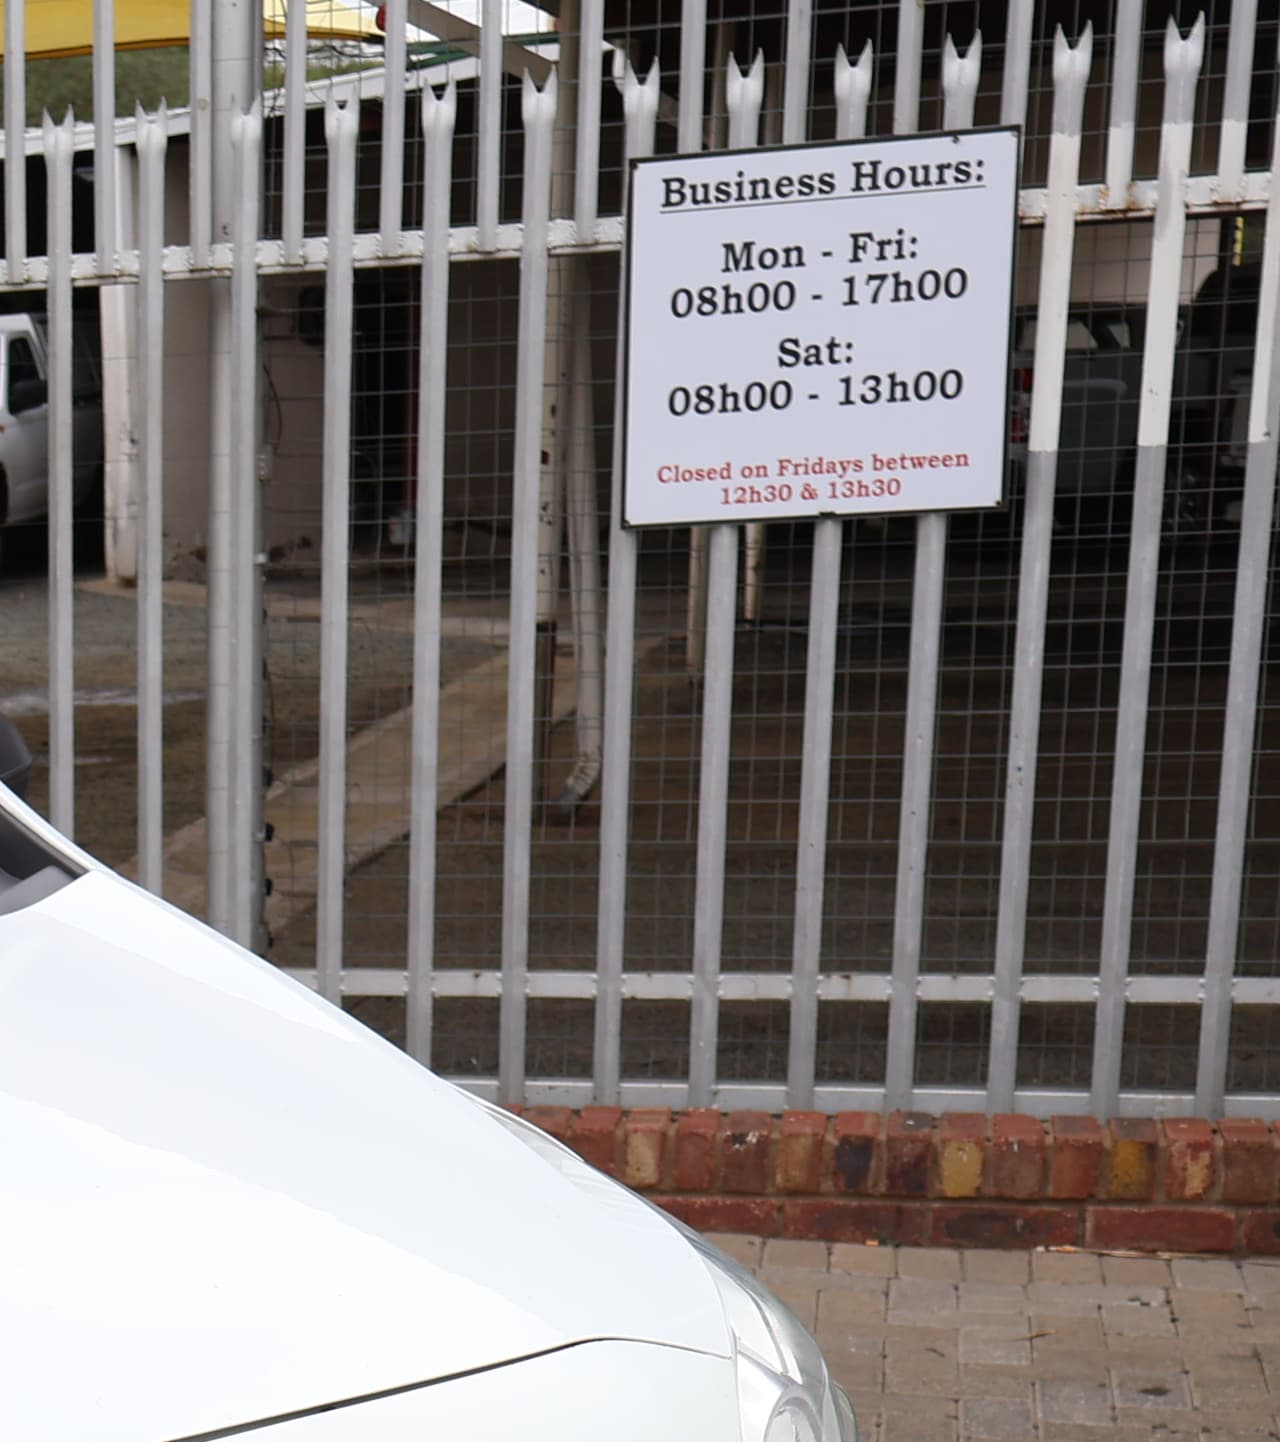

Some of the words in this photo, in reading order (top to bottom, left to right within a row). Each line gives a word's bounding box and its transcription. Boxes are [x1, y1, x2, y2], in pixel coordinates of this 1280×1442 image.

[659, 170, 836, 210] Business
[850, 157, 987, 194] Hours:
[721, 241, 806, 273] Mon
[848, 228, 918, 264] Fri:
[670, 280, 796, 319] 08h00
[842, 267, 969, 306] 17h00
[777, 336, 854, 368] Sat:
[668, 379, 793, 417] 08h00
[839, 369, 964, 406] 13h00
[657, 461, 732, 485] Closed
[740, 461, 769, 480] on
[777, 454, 864, 479] Fridays
[872, 450, 970, 473] between
[721, 481, 793, 506] 12h30
[801, 482, 819, 501] &
[828, 477, 902, 500] 13h30
